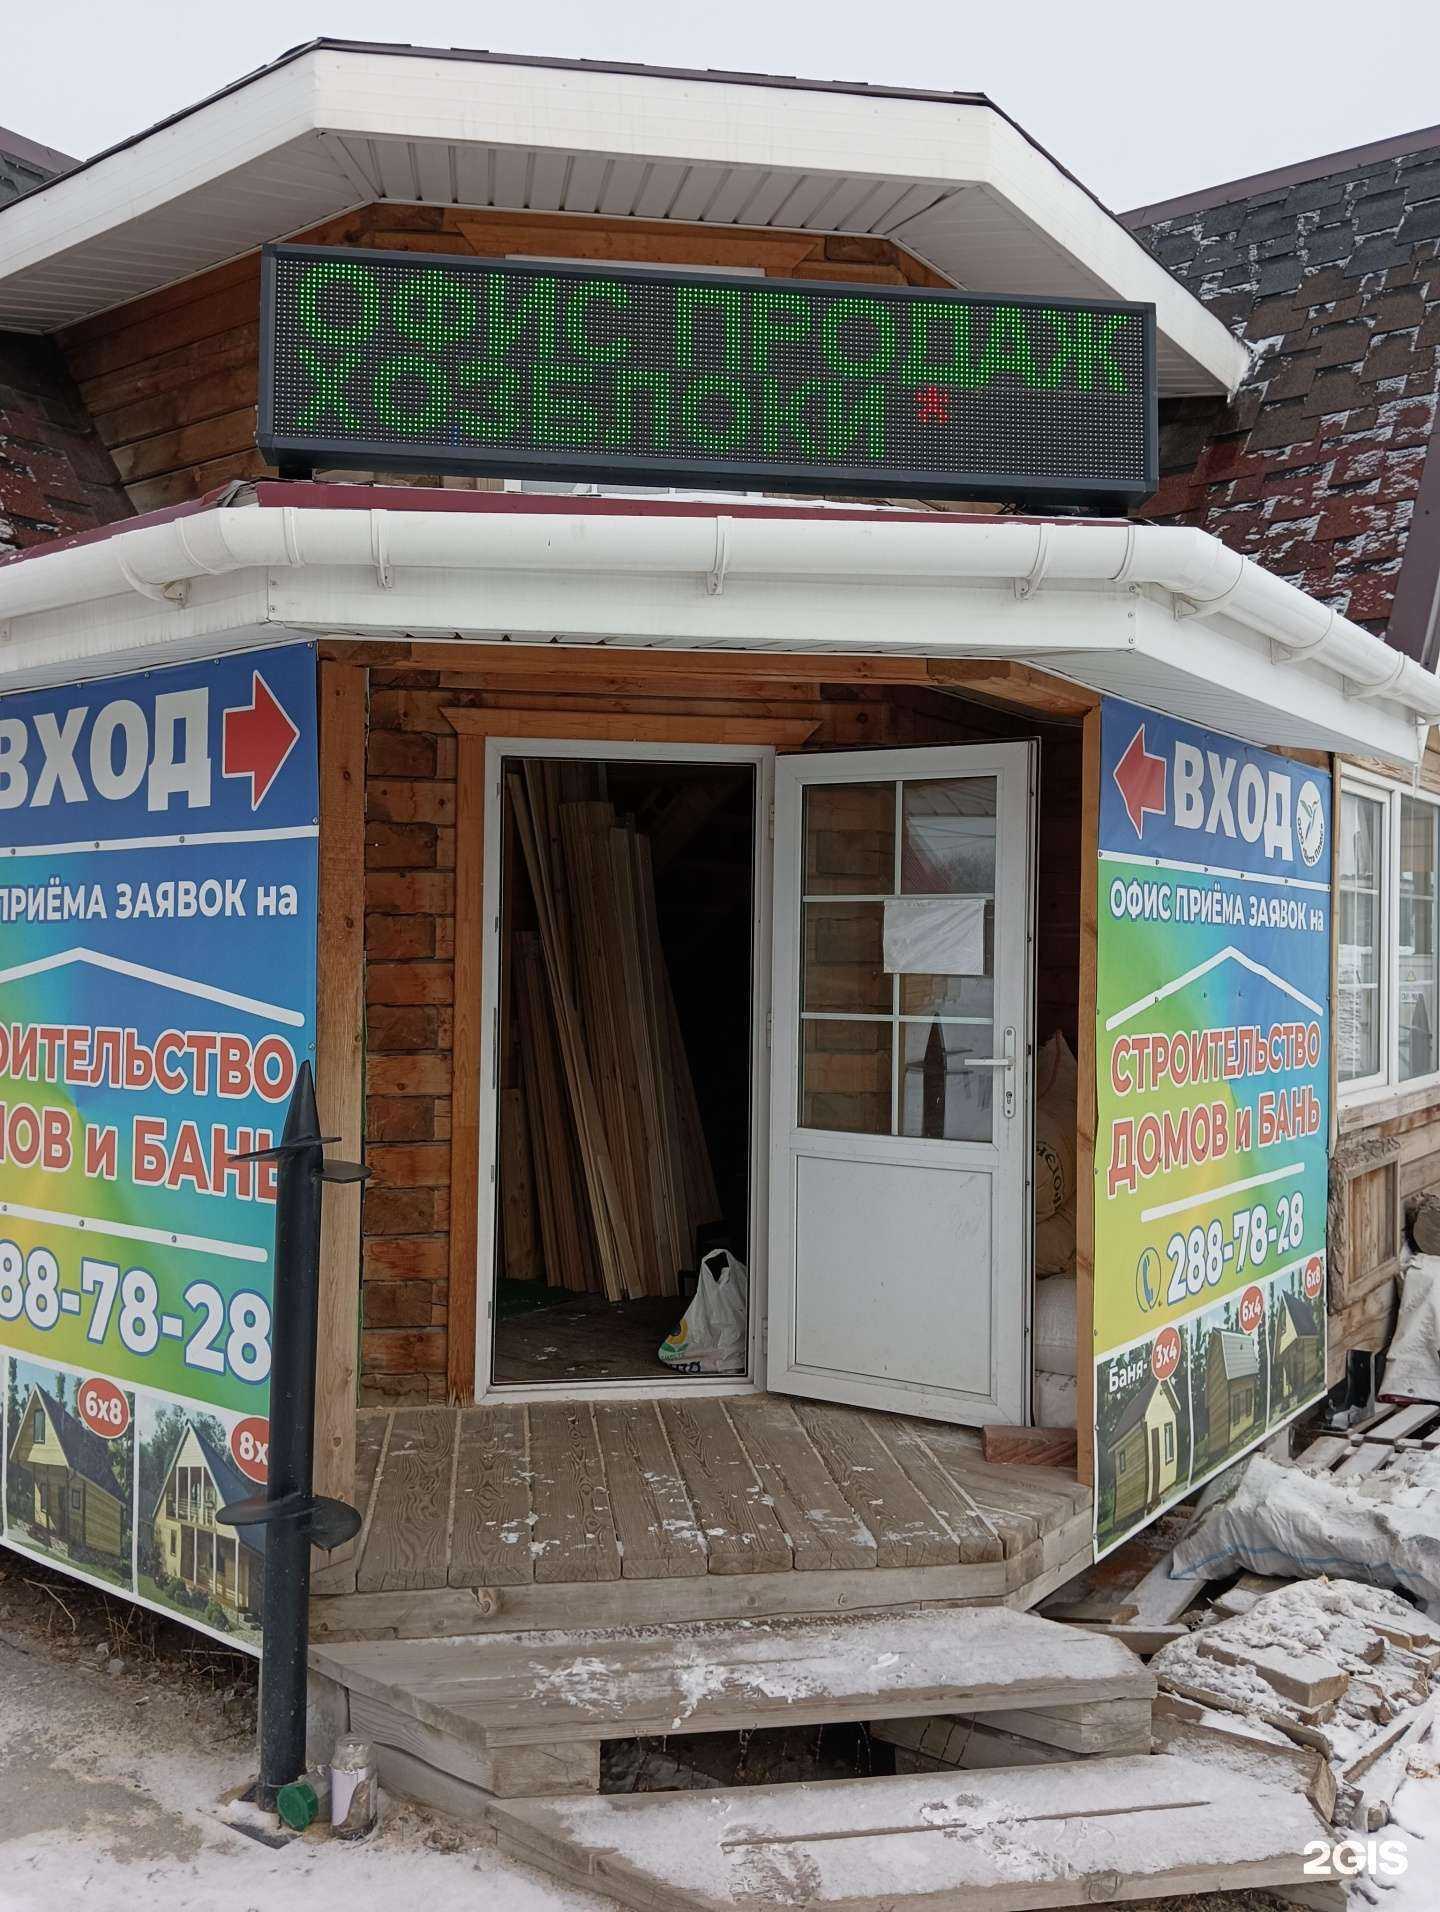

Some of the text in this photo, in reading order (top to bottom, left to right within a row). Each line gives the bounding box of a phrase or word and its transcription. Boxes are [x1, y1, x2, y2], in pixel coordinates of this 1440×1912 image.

[299, 263, 1131, 392] ОФИС ПРОДАЖ
[296, 348, 885, 459] ХОЗБЛОКИ
[1174, 741, 1294, 861] ВХОД
[116, 879, 247, 919] ЗАЯВОК
[257, 885, 298, 917] на
[1110, 879, 1324, 932] ОФИС ПРИЁМА ЗАЯВОК на
[1111, 1021, 1321, 1096] СТРОИТЕЛЬСТВО
[0, 1101, 73, 1173] ОВ
[85, 1123, 118, 1180] и
[1107, 1100, 1229, 1200] ДОМОВ
[1235, 1106, 1252, 1151] и
[1258, 1085, 1321, 1148] БАНЬ
[1166, 1192, 1304, 1306] 288-78-28
